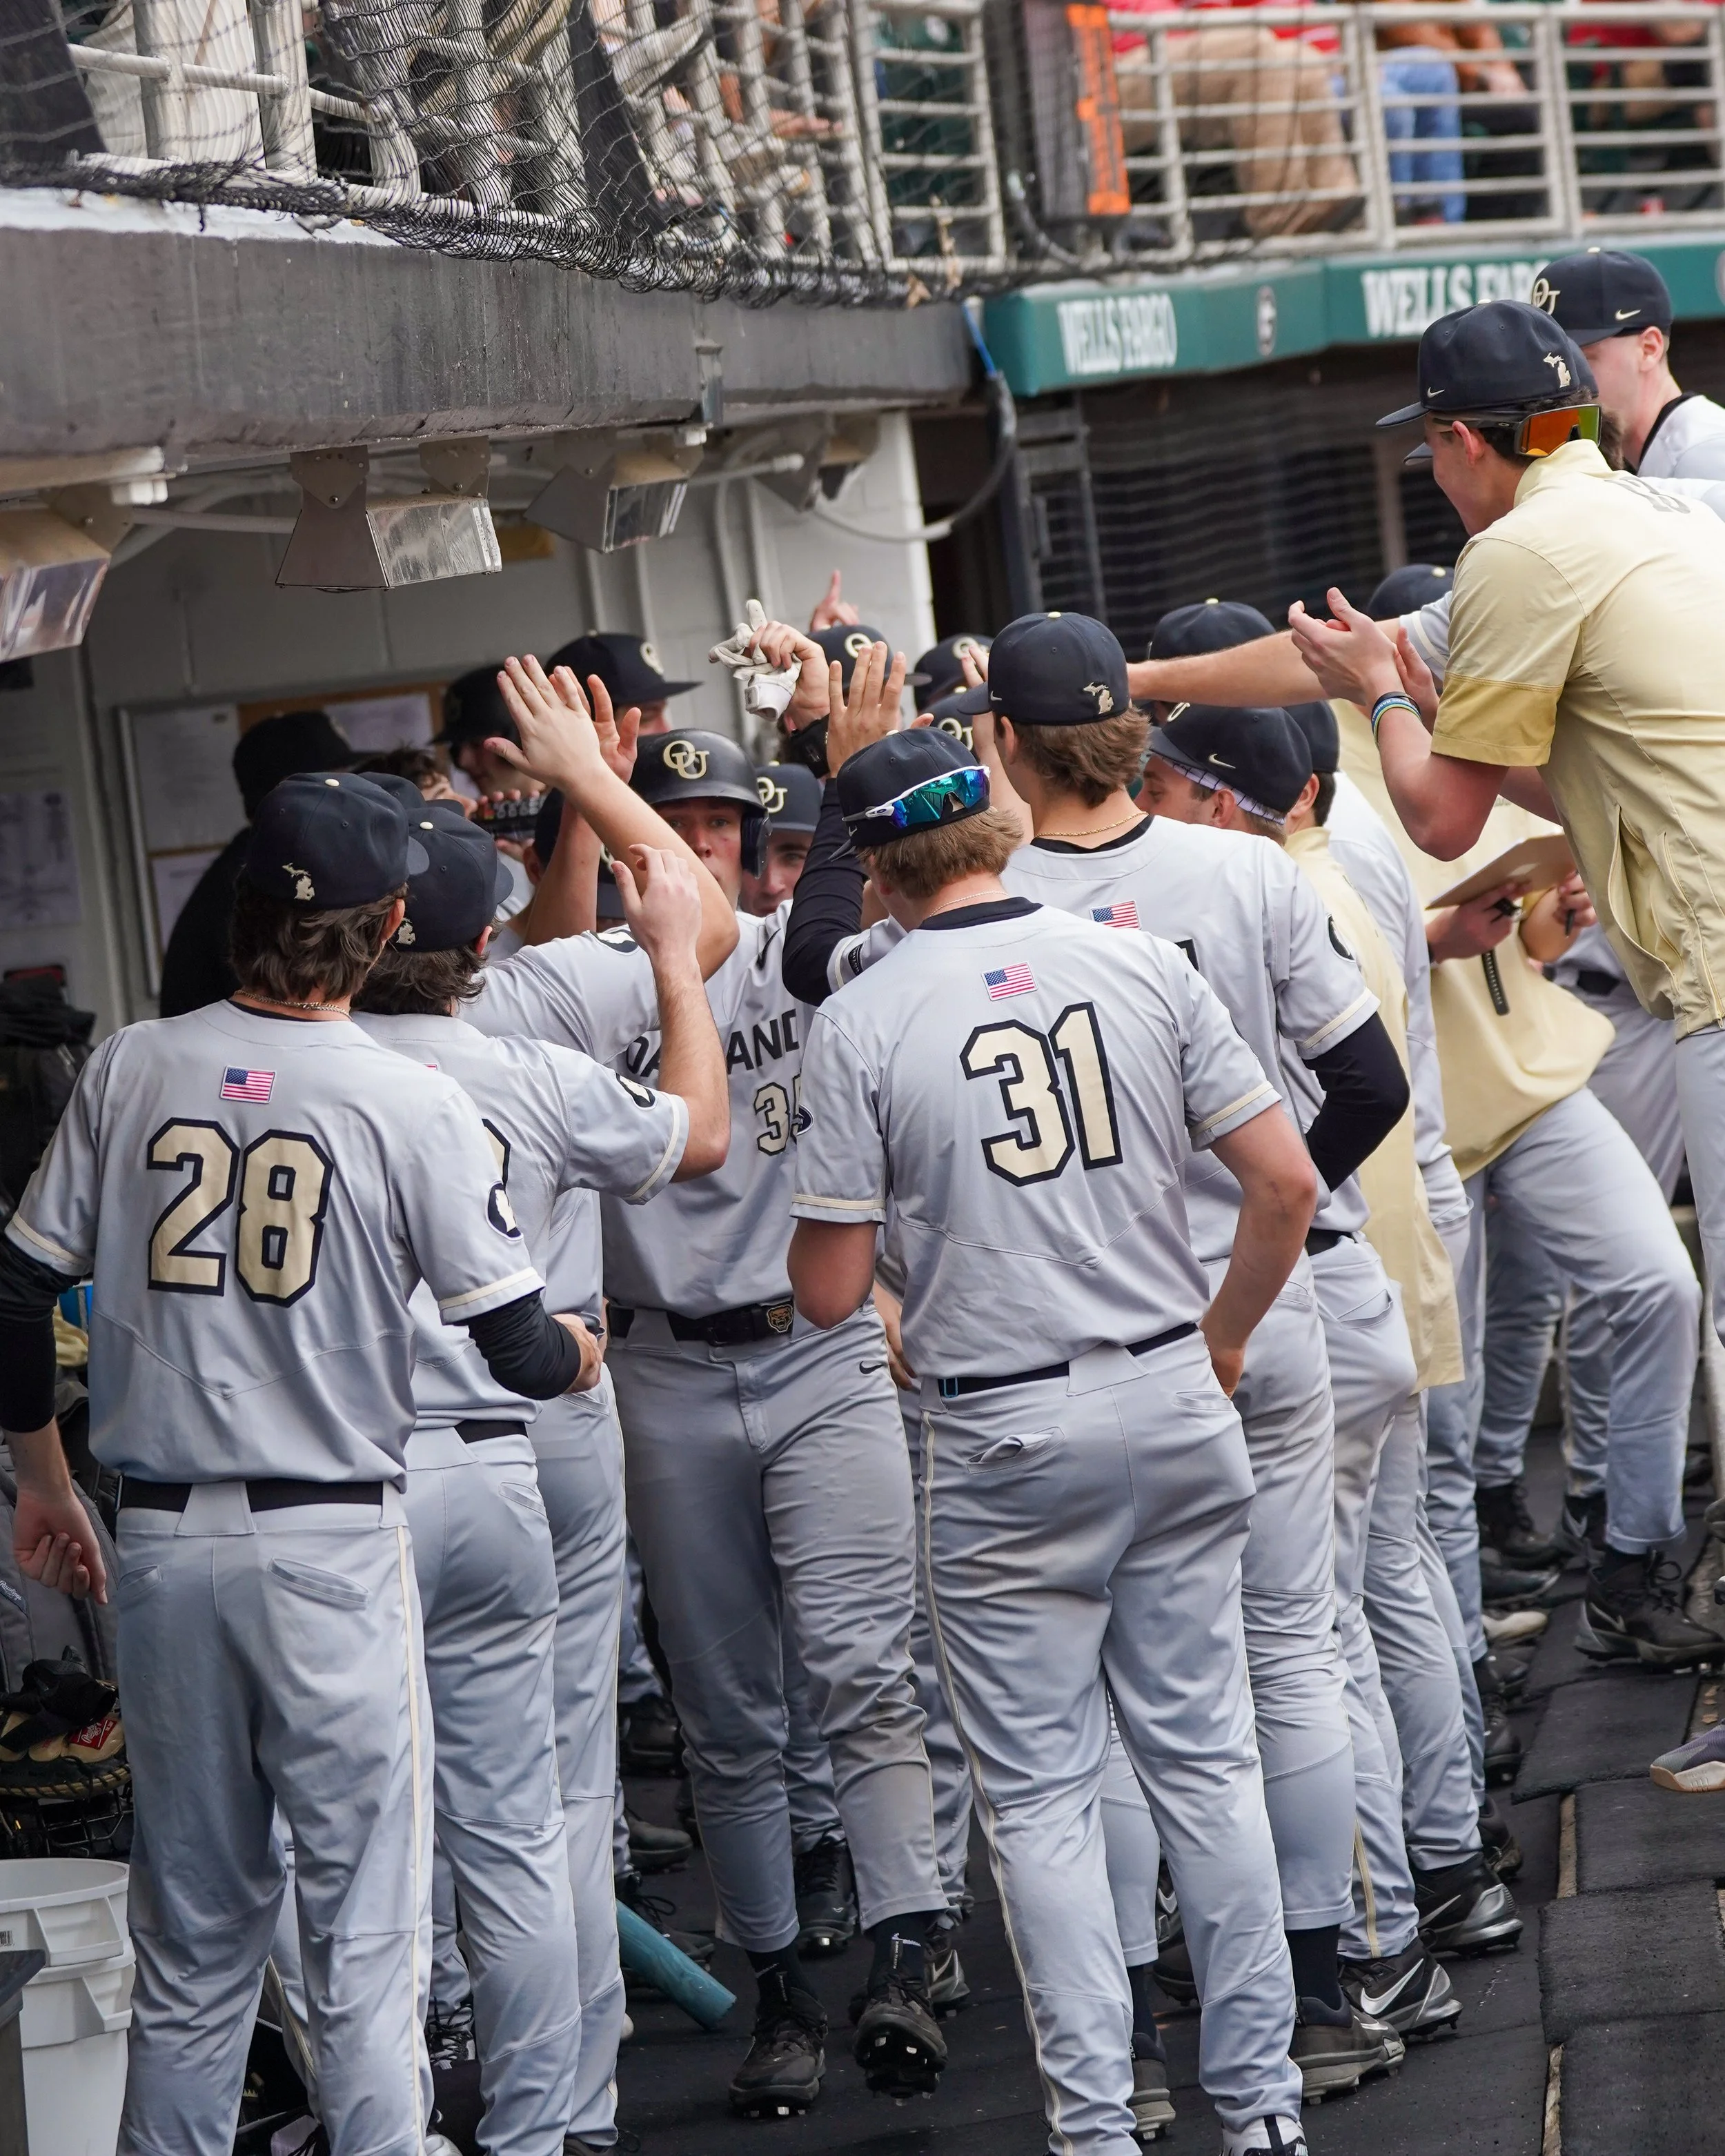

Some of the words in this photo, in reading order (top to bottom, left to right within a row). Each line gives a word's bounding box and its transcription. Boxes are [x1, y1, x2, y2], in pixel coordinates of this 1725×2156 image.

[1057, 296, 1123, 377] WELLS
[1116, 292, 1178, 368] FARGO
[1361, 264, 1475, 338] WELLS
[663, 740, 709, 780] OU
[959, 1002, 1123, 1187] 31
[146, 1117, 335, 1308] 28
